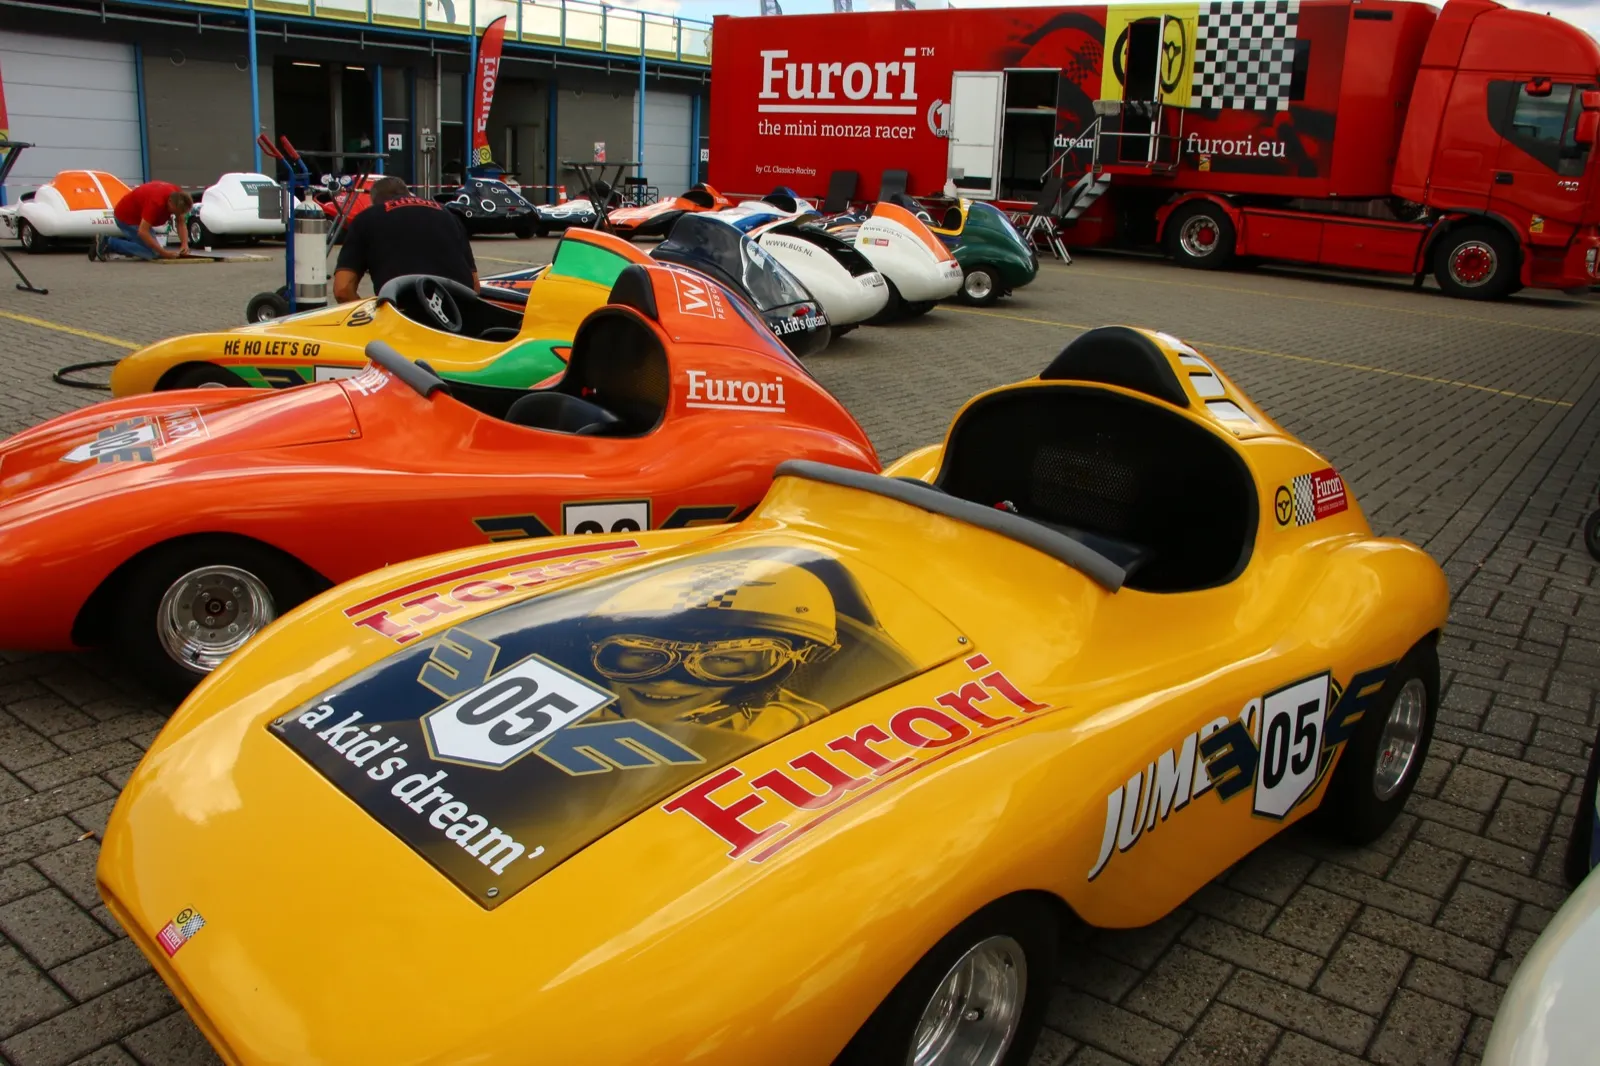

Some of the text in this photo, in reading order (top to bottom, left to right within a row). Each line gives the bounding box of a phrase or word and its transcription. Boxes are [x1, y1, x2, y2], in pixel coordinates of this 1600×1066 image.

[758, 47, 918, 100] Furori
[390, 137, 400, 147] 21
[758, 119, 916, 139] the mini monza racer
[1186, 132, 1286, 158] furori.eu
[772, 165, 816, 176] Classics-Racing
[765, 239, 813, 257] WWW.BUS.NL
[783, 316, 805, 333] kid's
[223, 339, 320, 357] HÉ HO LET'S GO
[686, 370, 786, 405] Furori
[353, 551, 648, 644] urori
[456, 675, 580, 747] 05
[316, 710, 409, 782] kid's
[660, 653, 1052, 860] Furori
[1262, 698, 1321, 790] 05
